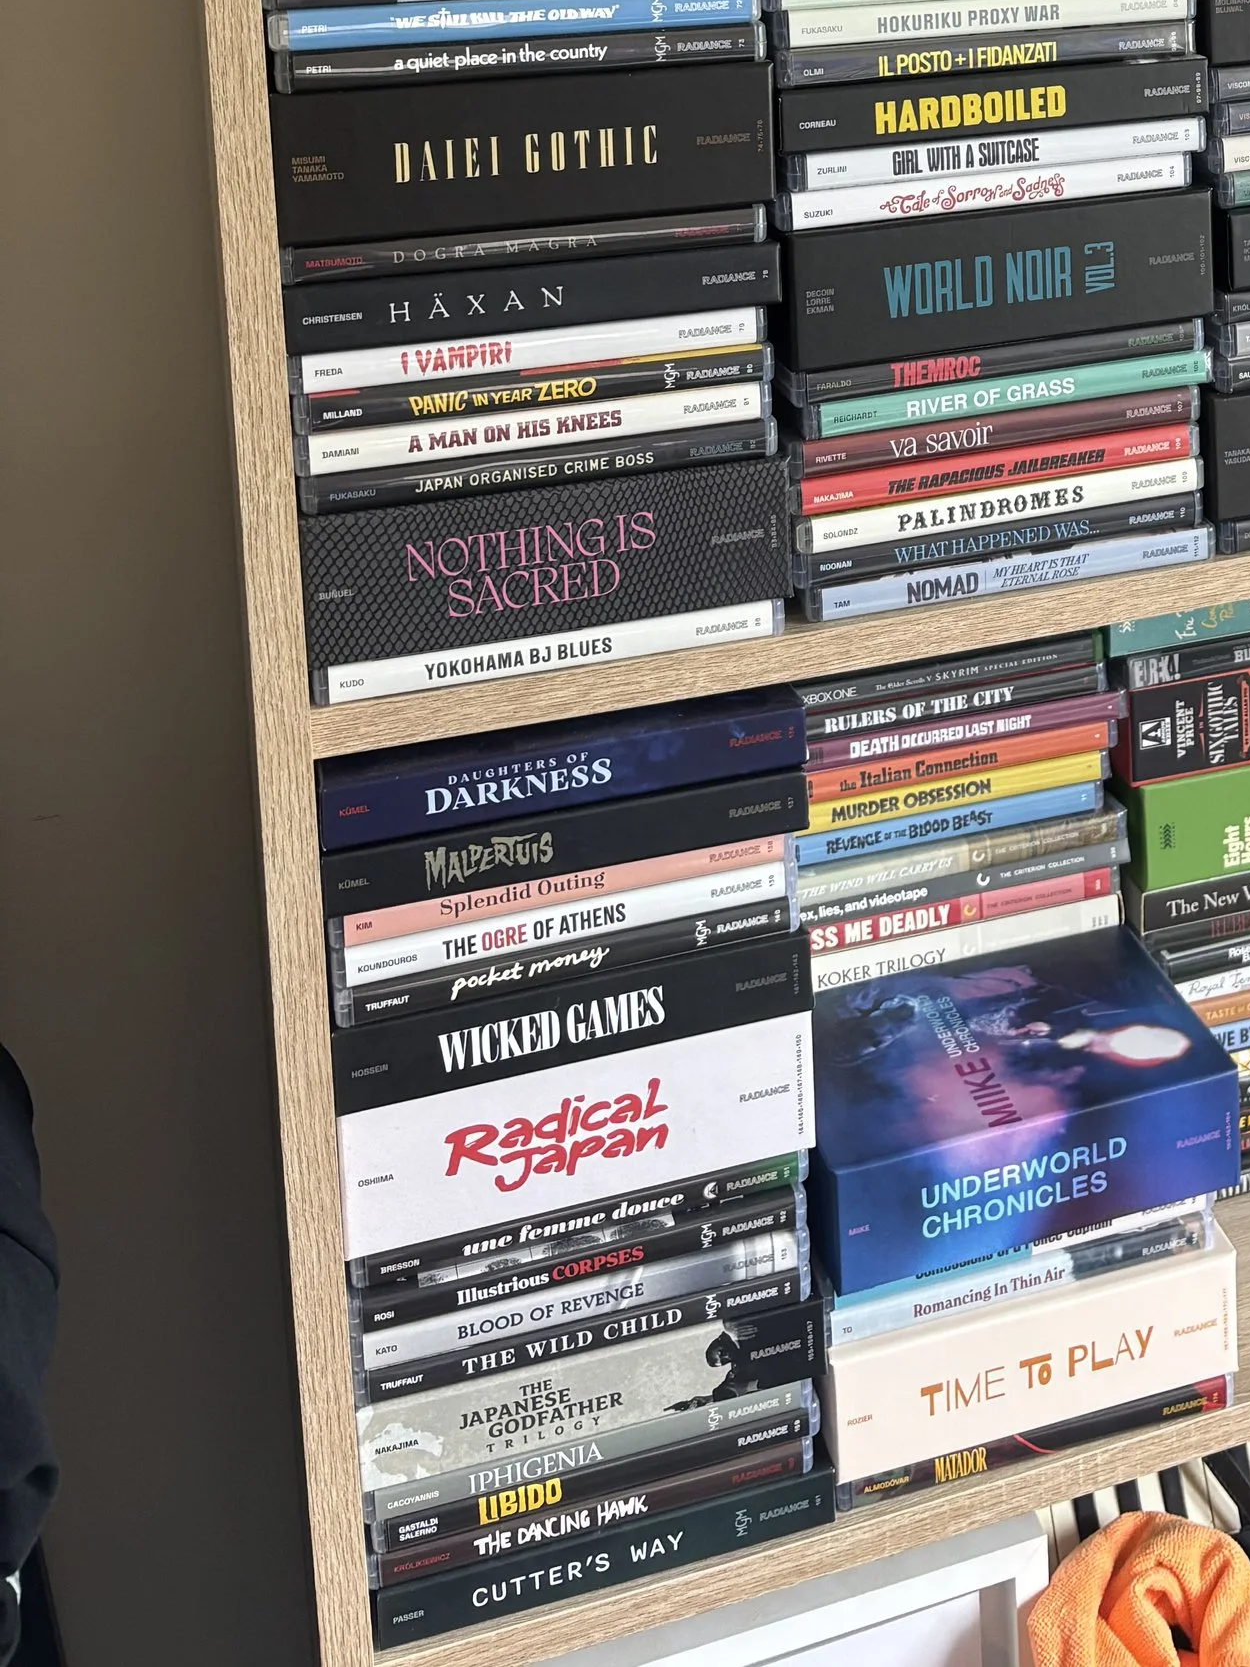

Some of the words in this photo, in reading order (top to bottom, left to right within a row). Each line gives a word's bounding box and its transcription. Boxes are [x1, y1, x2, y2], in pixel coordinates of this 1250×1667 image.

[799, 119, 836, 129] CORNEAU
[874, 85, 1066, 134] HARDBOILED
[394, 136, 500, 184] DAIEI
[525, 125, 658, 174] GOTHIC
[302, 312, 363, 325] CHRISTENSEN
[389, 286, 564, 323] HÄXAN
[323, 407, 362, 419] MILLAND
[408, 391, 467, 416] PANIC
[472, 392, 488, 405] IN
[490, 388, 533, 405] YEAR
[535, 377, 597, 401] ZERO
[907, 392, 967, 418] RIVER
[973, 388, 1001, 405] OF
[1006, 378, 1075, 403] GRASS
[898, 486, 1085, 532] PALINDROMES
[424, 652, 524, 680] YOKOHAMA
[530, 645, 552, 664] BJ
[557, 637, 613, 659] BLUES
[340, 678, 364, 688] KUDO
[1176, 700, 1185, 758] VINCENT
[1185, 706, 1194, 749] PRICE
[425, 757, 612, 815] DARKNESS
[448, 757, 558, 786] DAUGHTERS
[567, 752, 589, 764] OF
[831, 792, 900, 823] MURDER
[903, 779, 992, 810] OBSESSION
[1224, 825, 1240, 867] Eight
[1167, 896, 1199, 917] The
[1204, 892, 1239, 910] New
[921, 1136, 1127, 1209] UNDERWORLD
[922, 1170, 1108, 1239] CHRONICLES
[913, 1289, 991, 1319] Romancing
[994, 1282, 1007, 1297] In
[1010, 1273, 1045, 1295] Thin
[1046, 1266, 1066, 1283] Air
[462, 1347, 516, 1375] THE
[526, 1329, 593, 1359] WILD
[603, 1308, 683, 1340] CHILD
[920, 1367, 1004, 1417] TIME
[1067, 1325, 1154, 1378] PLAY
[472, 1552, 611, 1607] CUTTER'S
[631, 1530, 684, 1565] WAY
